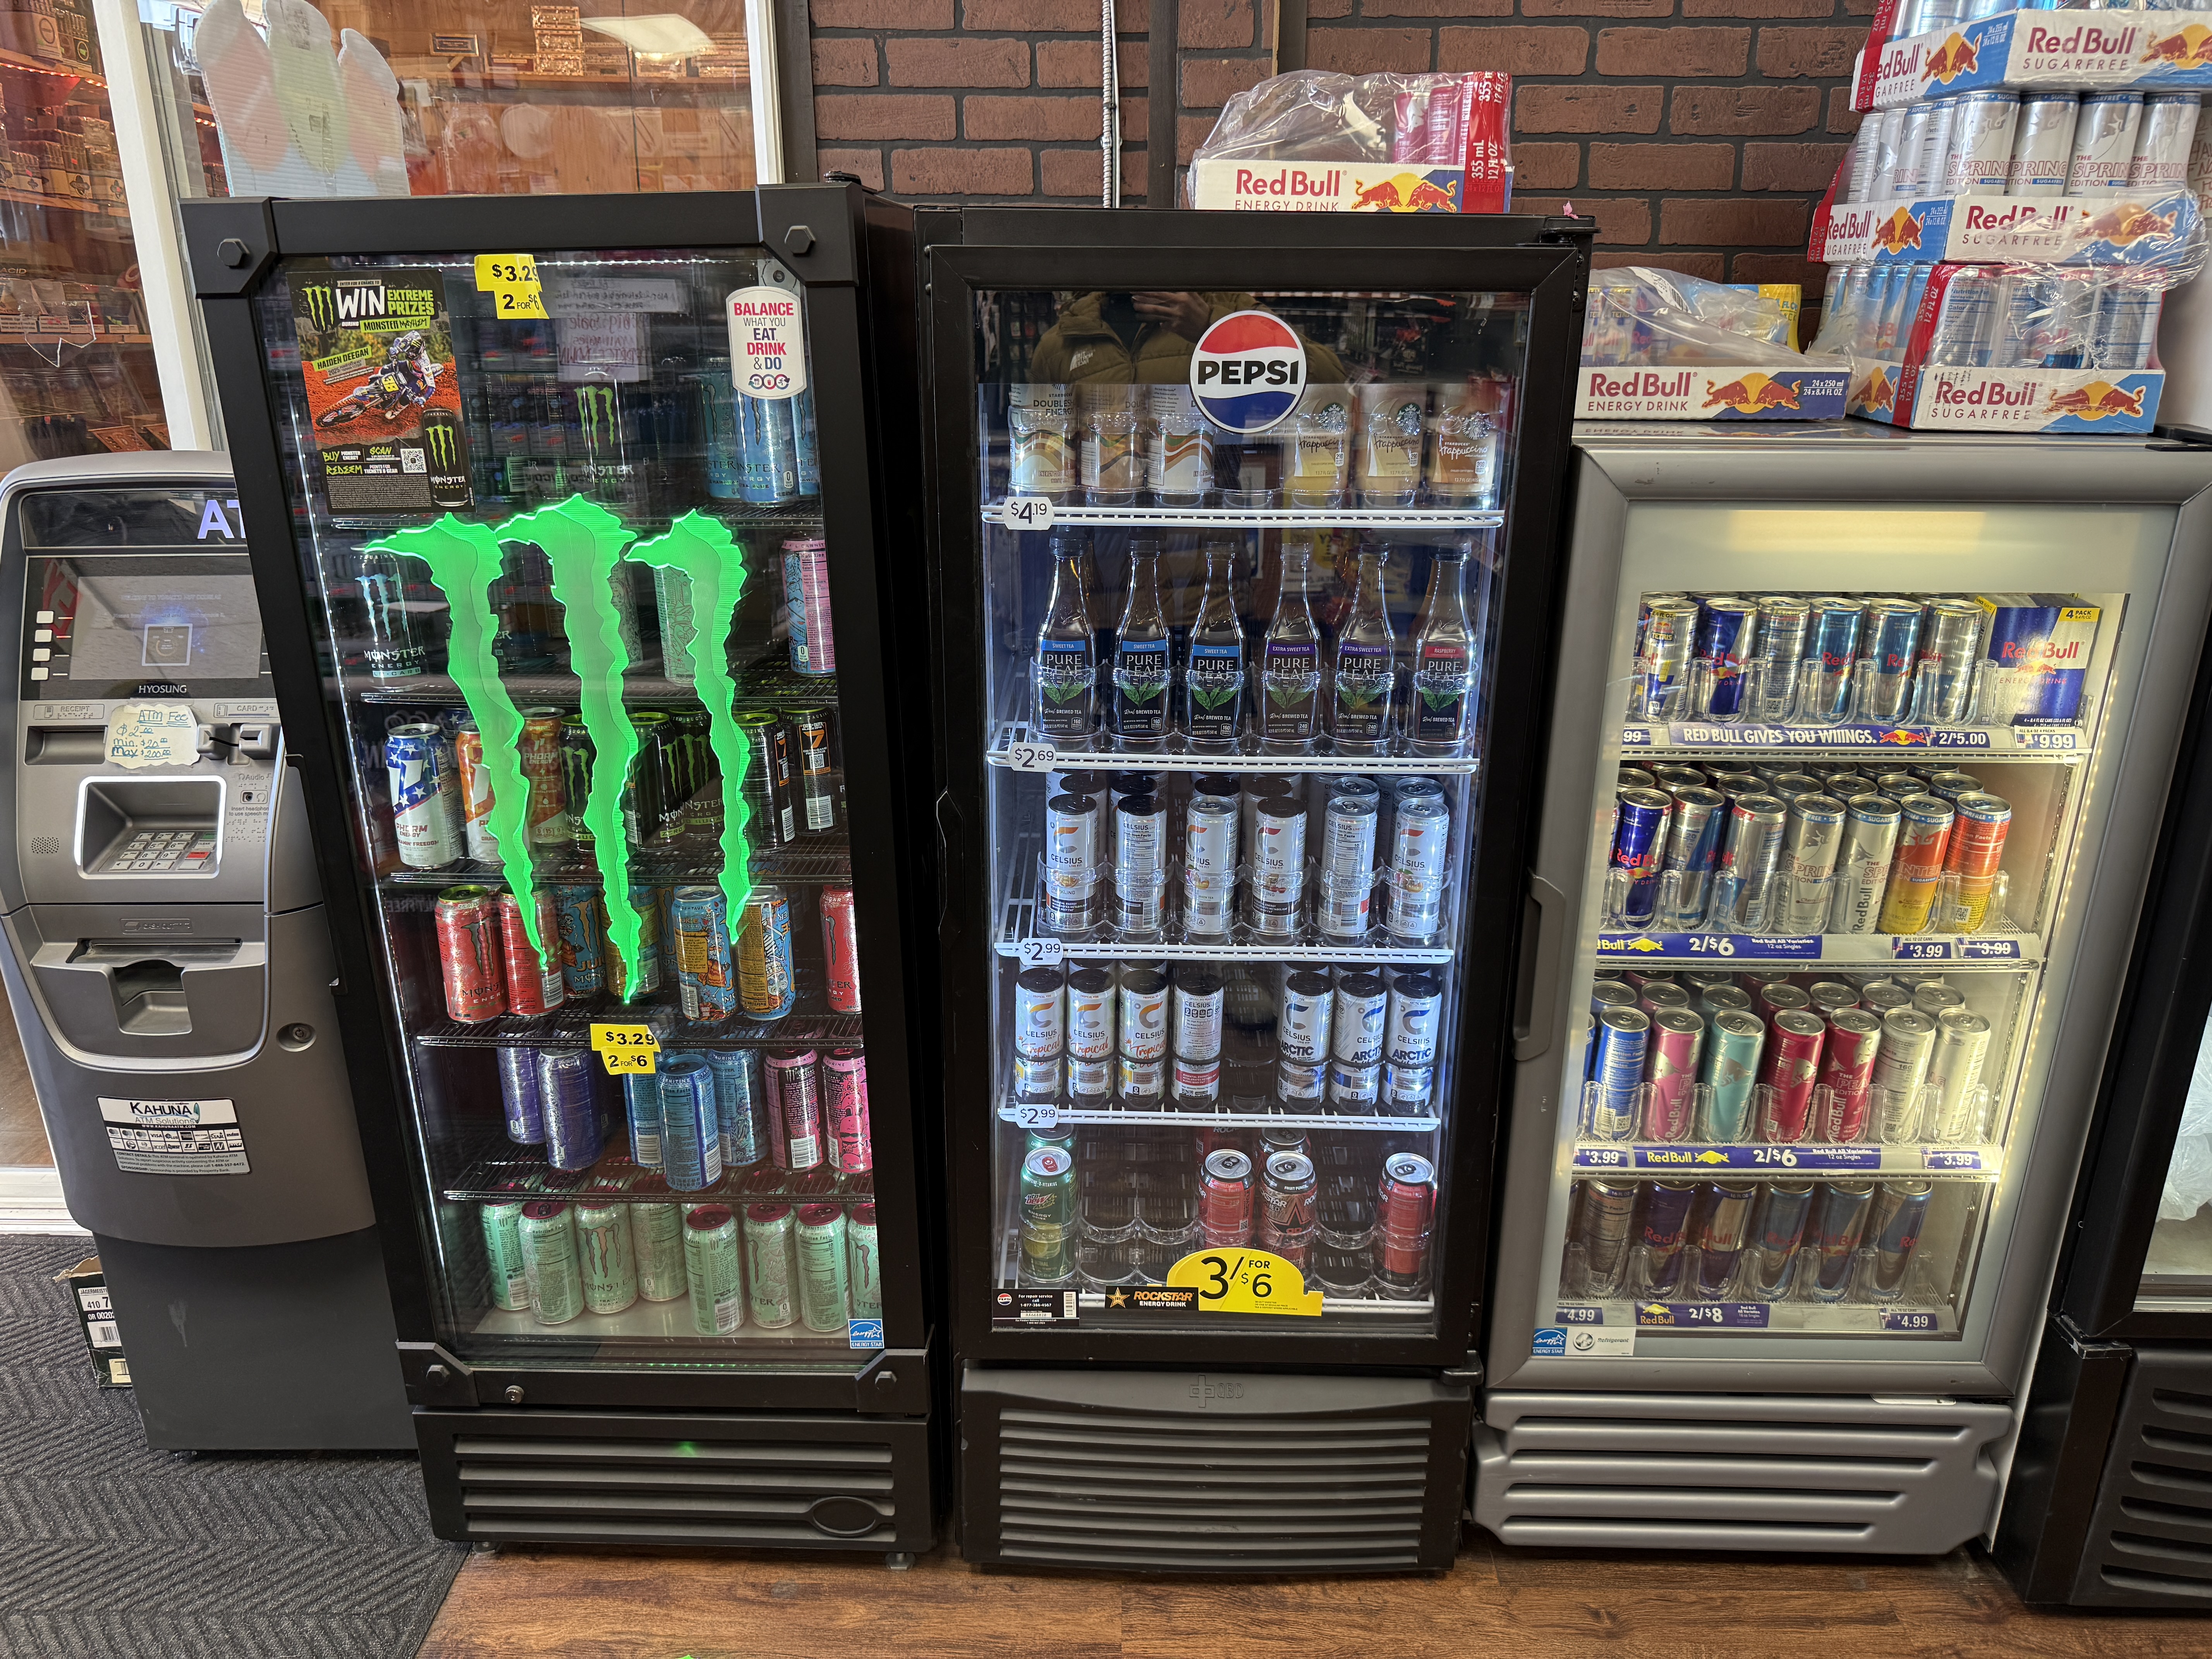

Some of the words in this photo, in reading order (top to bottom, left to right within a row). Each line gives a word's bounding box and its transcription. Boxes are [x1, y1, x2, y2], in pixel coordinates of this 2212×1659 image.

[2027, 26, 2082, 55] Red
[2083, 26, 2136, 55] Bull
[1876, 50, 1894, 82] ed
[1892, 43, 1920, 77] Bull
[2023, 58, 2129, 71] SUGARFREE
[1473, 140, 1484, 157] mL
[1488, 141, 1498, 157] OZ
[1471, 160, 1484, 179] 355
[1488, 159, 1498, 167] FL
[1488, 169, 1498, 179] 12
[1236, 169, 1286, 196] Red
[1291, 170, 1341, 197] Bull
[1235, 201, 1291, 211] ENERGY
[1296, 202, 1338, 212] DRINK
[1965, 205, 2017, 229] Red
[1827, 212, 1849, 239] Red
[1848, 210, 1872, 239] Bull
[1962, 234, 2062, 246] SUGARFREE
[492, 263, 539, 282] $3.29
[387, 290, 434, 301] EXTREME
[503, 294, 515, 310] 2
[528, 294, 539, 310] $6
[336, 286, 385, 319] WIN
[388, 302, 435, 315] PRIZES
[733, 302, 794, 316] BALANCE
[364, 321, 398, 331] MONSTER
[743, 318, 767, 326] WHAT
[769, 318, 786, 326] YOU
[753, 328, 778, 342] EAT,
[747, 343, 787, 355] DRINK
[317, 356, 342, 370] HAIDEN
[343, 348, 369, 361] DEEGAN
[753, 357, 762, 369] &
[764, 357, 782, 370] DO
[1197, 360, 1299, 385] PEPSI
[1590, 372, 1641, 397] Red
[1642, 372, 1690, 397] Bull
[1935, 381, 1986, 405] Red
[1986, 381, 2037, 405] Bull
[1587, 401, 1642, 411] ENERGY
[1647, 401, 1688, 411] DRINK
[1931, 408, 2031, 420] SUGARFREE
[322, 451, 340, 462] BUY
[370, 447, 392, 455] SCAN
[1011, 501, 1047, 524] $4.19
[2042, 641, 2079, 659] Bull
[372, 660, 419, 668] ENERGY
[1046, 654, 1082, 665] PURE
[1127, 654, 1162, 665] PURE
[1197, 659, 1234, 671] PURE
[1273, 658, 1310, 669] PURE
[1344, 658, 1381, 669] PURE
[1428, 661, 1460, 672] PURE
[139, 685, 187, 694] HYOSUNG
[137, 709, 163, 722] ATM
[1683, 728, 1709, 742] RED
[1712, 729, 1742, 742] BULL
[1744, 730, 1783, 744] GIVES
[1786, 730, 1816, 744] YOU
[1939, 732, 1986, 746] 2/$5.00
[1014, 748, 1054, 769] $2.69
[1051, 854, 1083, 864] CELSIUS
[1024, 943, 1060, 960] $2.99
[1689, 936, 1735, 956] 2/$6
[1910, 945, 1943, 957] $3.99
[606, 1031, 655, 1045] $3.29
[1026, 1029, 1058, 1039] CELSIUS
[1073, 1029, 1105, 1039] CELSIUS
[1135, 1028, 1165, 1039] CELSIUS
[1283, 1027, 1311, 1041] CELSIUS
[608, 1055, 619, 1068] 2
[631, 1054, 647, 1067] $6
[1392, 1048, 1432, 1061] ARCTIC
[130, 1102, 192, 1115] KAHUNA
[1020, 1108, 1056, 1125] $2.99
[1585, 1150, 1619, 1164] $3.99
[1647, 1152, 1670, 1163] Red
[1670, 1152, 1692, 1163] Bull
[1753, 1149, 1797, 1166] 2/$6
[1249, 1261, 1270, 1269] FOR
[1199, 1256, 1245, 1300] 3/
[1241, 1271, 1272, 1298] $6
[1133, 1291, 1194, 1302] ROCKSTAR
[1564, 1309, 1595, 1321] $4.99
[1640, 1316, 1657, 1324] Red
[1657, 1316, 1675, 1324] Bull
[1688, 1307, 1723, 1322] 2/$8
[1897, 1315, 1929, 1328] $4.99
[1216, 1382, 1244, 1400] QBD
